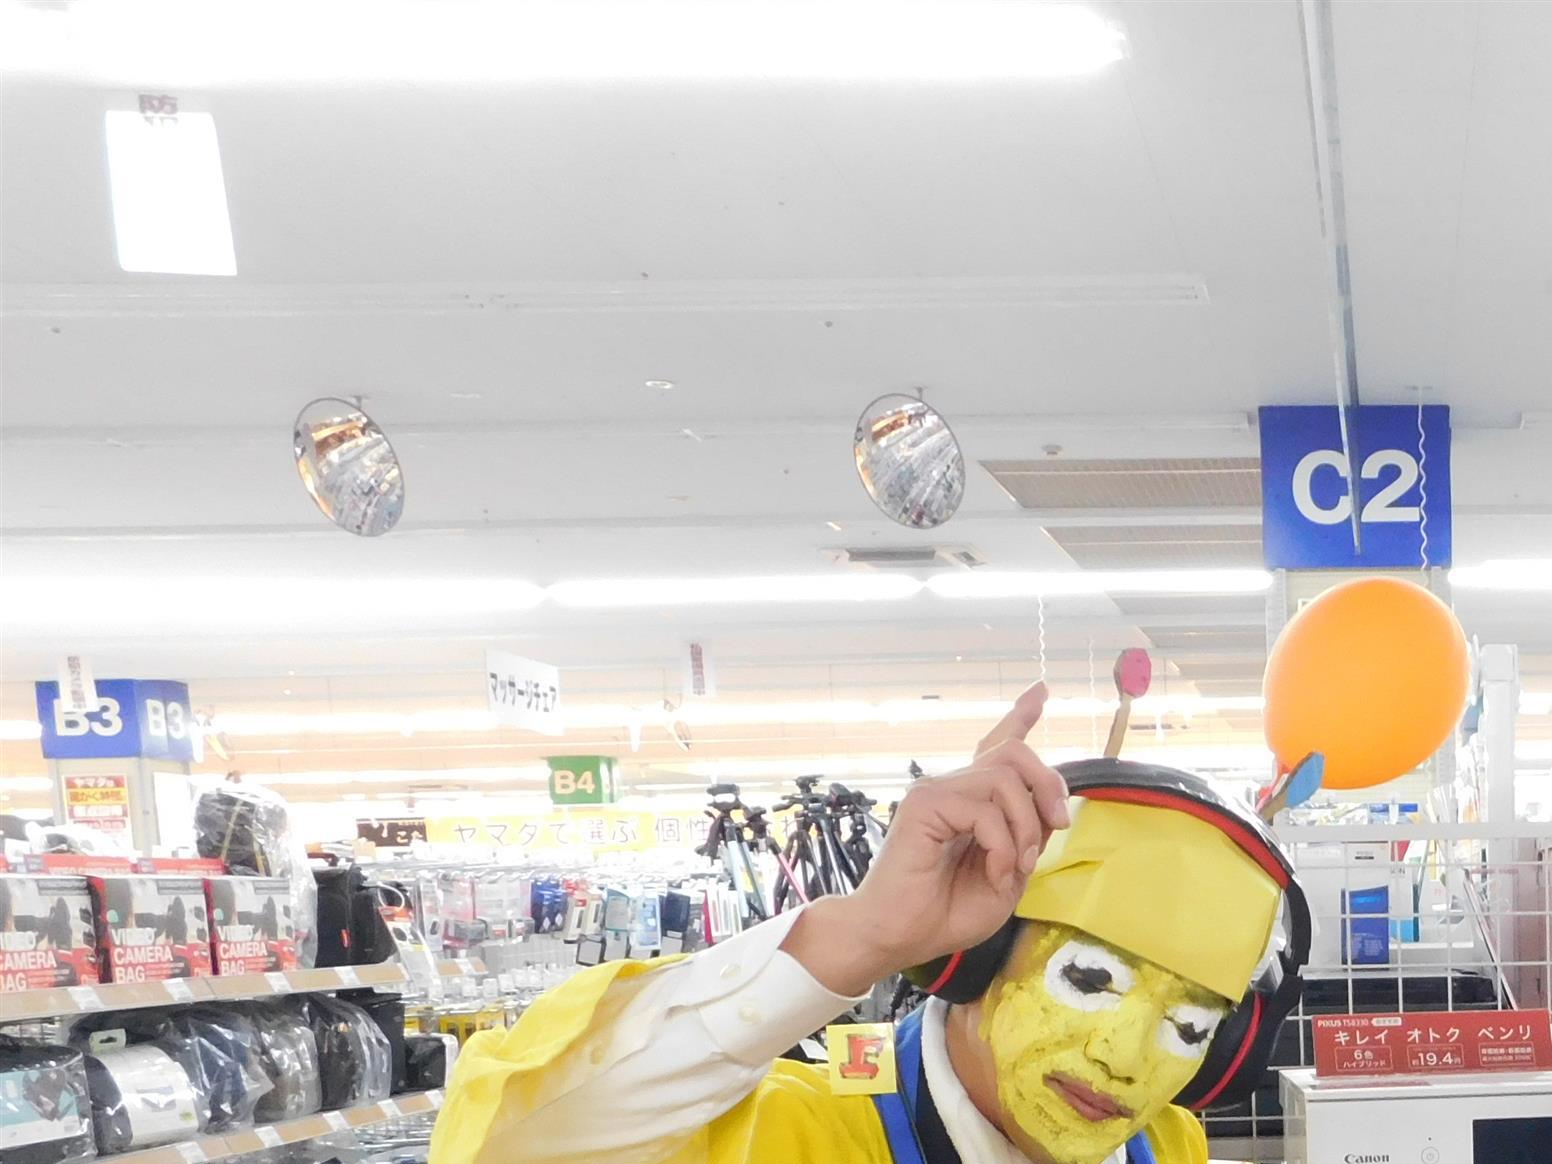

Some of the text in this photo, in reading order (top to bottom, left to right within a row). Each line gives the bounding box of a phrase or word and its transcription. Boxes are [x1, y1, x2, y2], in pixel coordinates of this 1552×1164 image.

[1292, 448, 1420, 525] C2
[488, 671, 557, 713] マッサージチェア
[53, 697, 123, 737] B3
[146, 698, 184, 740] B3
[554, 769, 596, 794] B4
[0, 951, 57, 970] AMERA
[114, 946, 174, 966] CAMERA
[219, 942, 268, 959] CAMERA
[116, 966, 146, 983] BAG
[221, 960, 246, 976] BAG
[1317, 1019, 1342, 1028] PIXUS
[1333, 1024, 1532, 1046] キレイ オトク ベンリ
[1343, 1152, 1390, 1164] Canon
